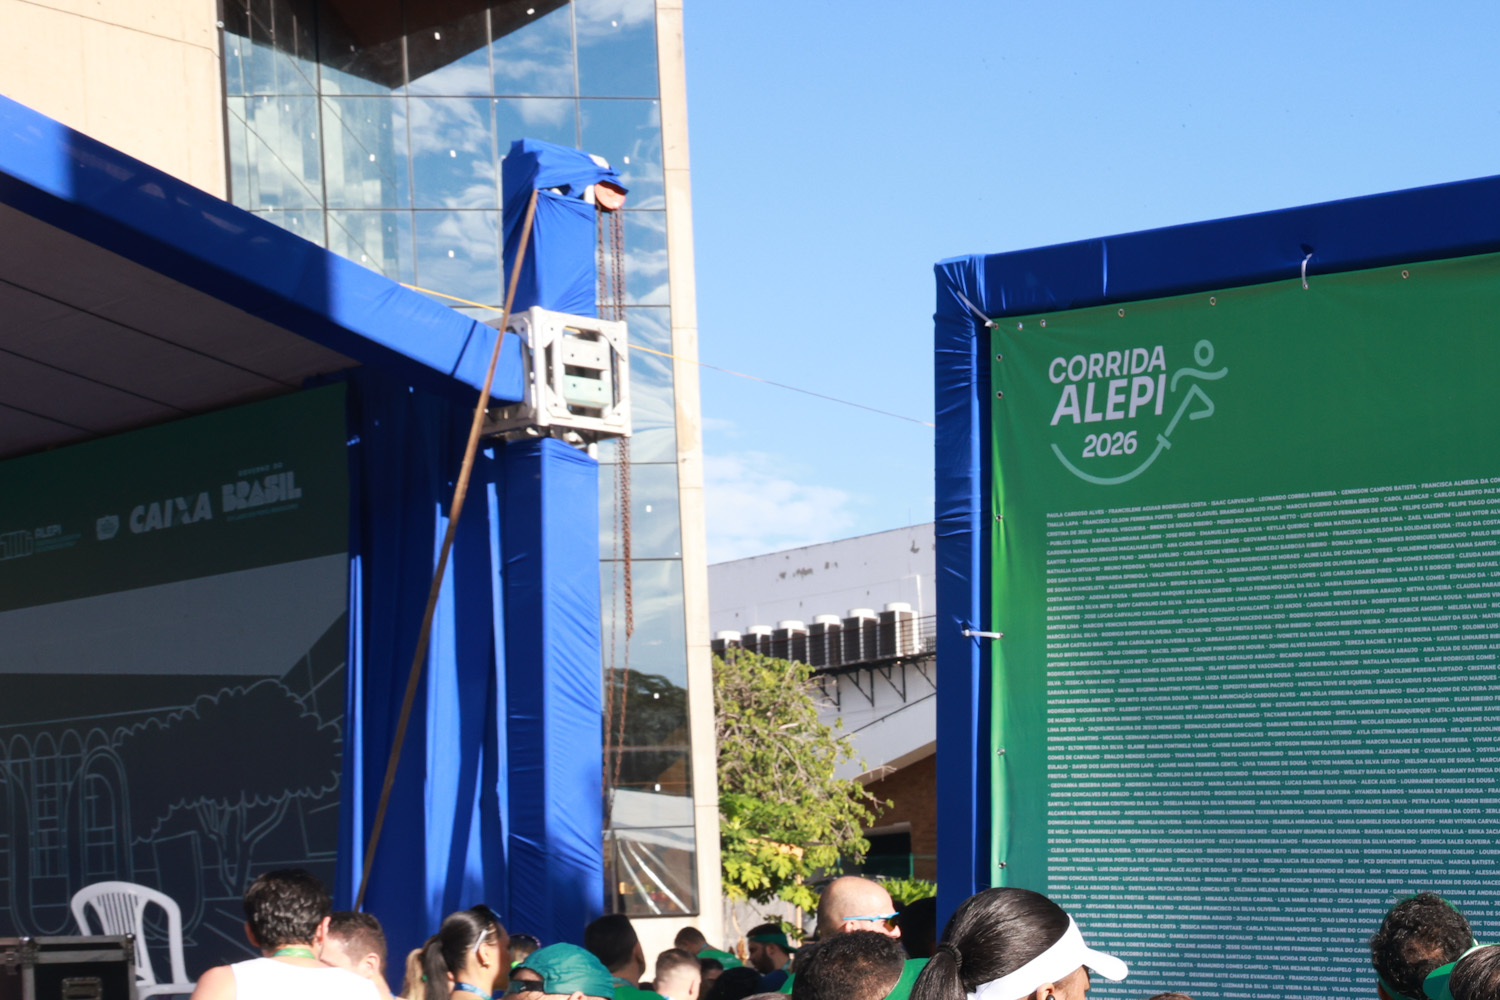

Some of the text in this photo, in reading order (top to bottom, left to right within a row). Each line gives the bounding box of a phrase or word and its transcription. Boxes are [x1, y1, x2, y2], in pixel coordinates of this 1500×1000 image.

[1049, 346, 1166, 384] CORRIDA
[1050, 374, 1166, 426] ALEPI
[1082, 430, 1138, 458] 2026
[129, 492, 213, 534] CAIXA
[221, 471, 302, 513] BRASIL
